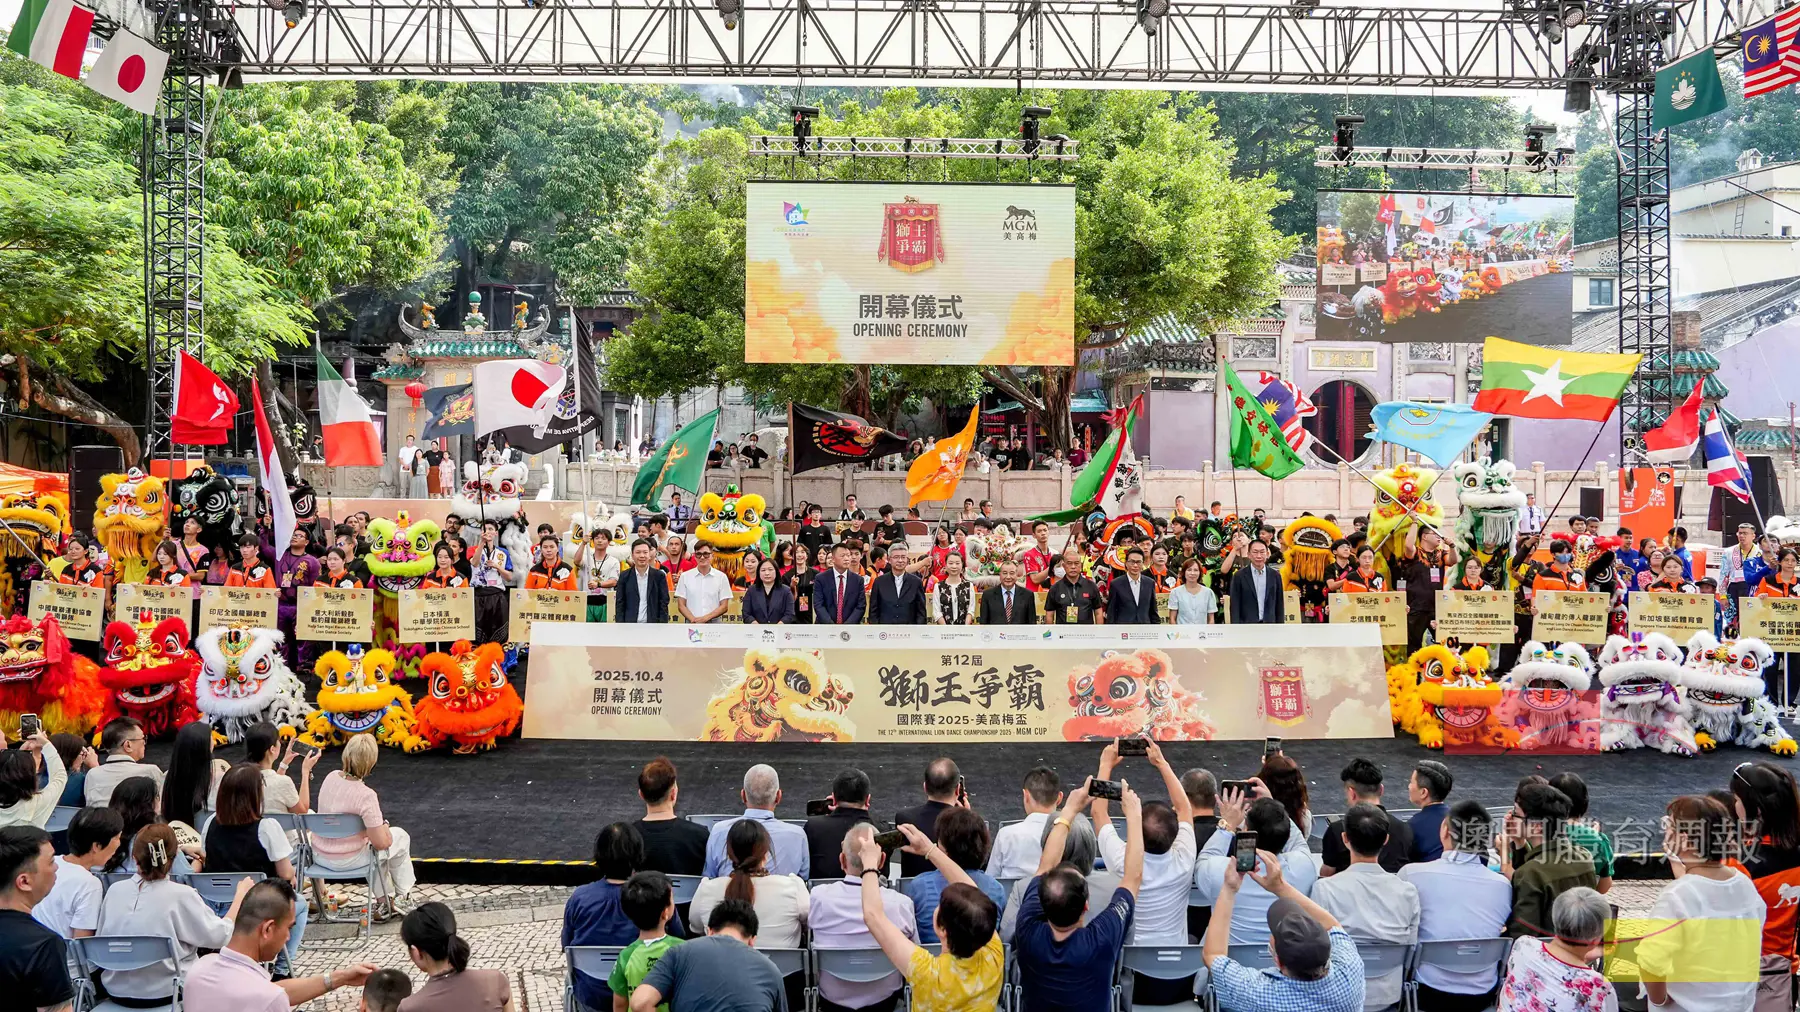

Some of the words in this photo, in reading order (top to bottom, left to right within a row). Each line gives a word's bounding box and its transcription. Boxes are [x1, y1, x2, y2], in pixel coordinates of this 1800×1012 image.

[895, 222, 927, 238] 獅王
[1002, 220, 1037, 231] MGM
[1003, 231, 1037, 241] 美高梅
[895, 238, 927, 254] 爭霸
[858, 293, 963, 320] 開幕儀式
[853, 323, 902, 337] OPENING
[907, 323, 969, 338] CEREMONY
[519, 612, 576, 621] 澳門羅梁體育總會
[940, 654, 983, 666] 第12屆
[594, 670, 664, 682] 2025.10.4
[878, 664, 1045, 712] 獅王爭霸
[1269, 683, 1297, 697] 獅王
[593, 688, 662, 704] 開幕儀式
[591, 706, 622, 714] OPENING
[624, 706, 662, 715] CEREMONY
[1270, 697, 1297, 711] 爭霸
